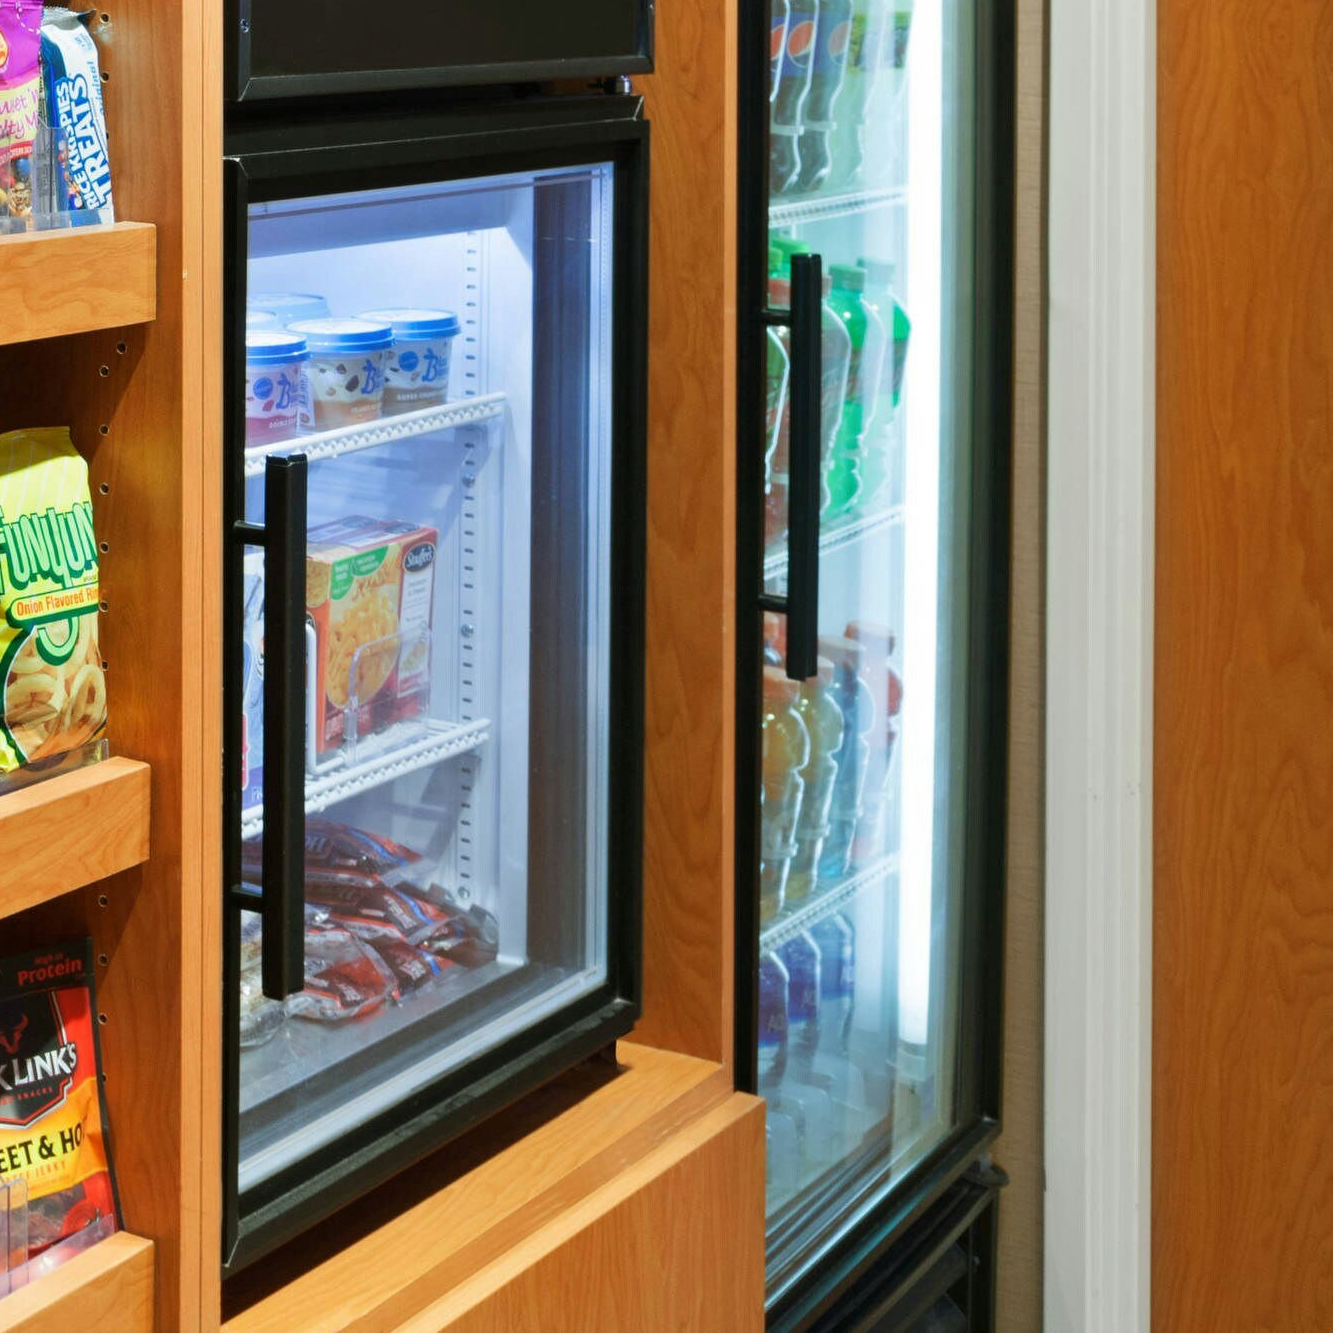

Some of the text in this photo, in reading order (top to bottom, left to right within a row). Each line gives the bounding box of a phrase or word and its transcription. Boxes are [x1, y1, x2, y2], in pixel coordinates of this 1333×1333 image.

[68, 76, 113, 203] TREATS
[74, 171, 100, 210] RICE
[16, 591, 85, 617] Onion Flavored
[17, 958, 82, 987] Protein
[13, 1043, 77, 1086] LINK'S
[38, 1134, 55, 1160] &
[60, 1123, 83, 1155] HO
